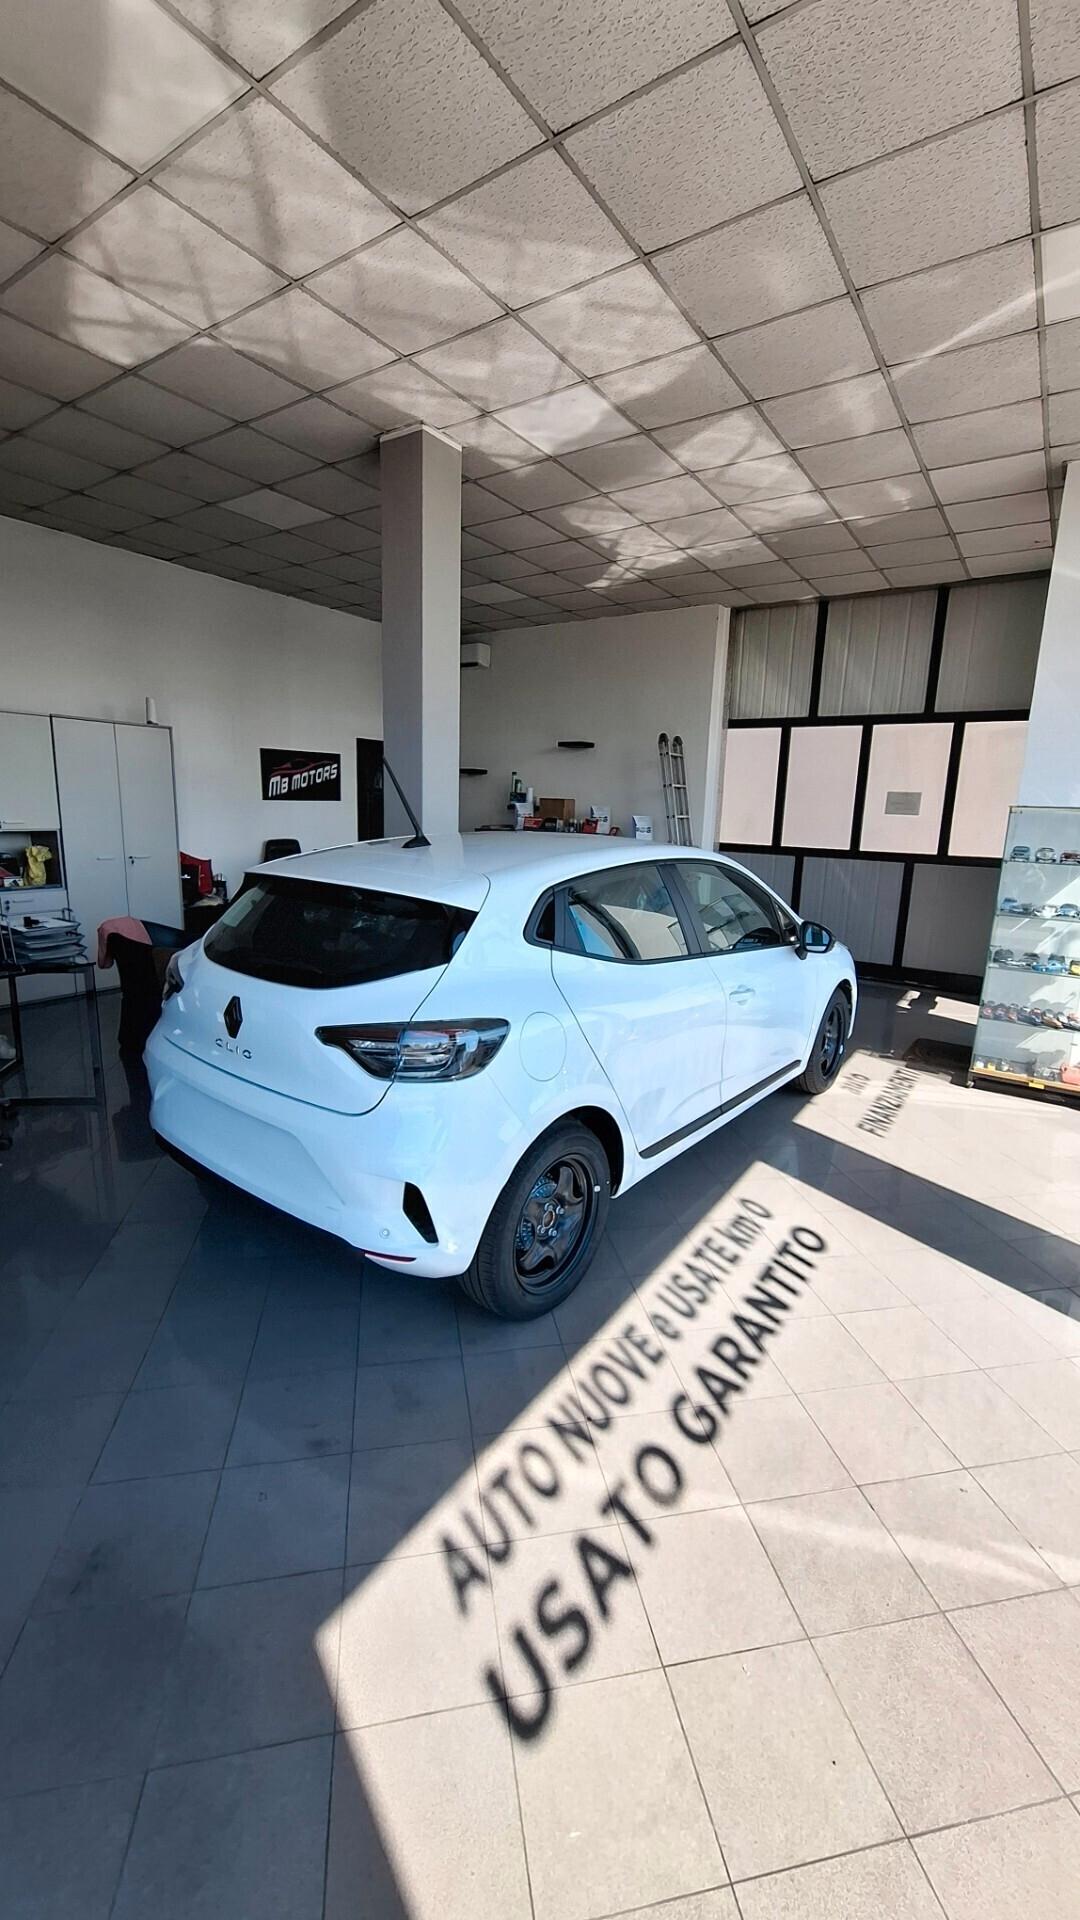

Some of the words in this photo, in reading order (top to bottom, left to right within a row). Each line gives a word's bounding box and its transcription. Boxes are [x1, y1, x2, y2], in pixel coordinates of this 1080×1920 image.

[268, 775, 289, 797] MB
[291, 763, 338, 790] MOTORS
[215, 1038, 252, 1060] CLIO
[712, 1215, 763, 1250] km
[656, 1237, 741, 1321] USATE
[652, 1313, 680, 1339] e
[546, 1324, 664, 1461] NUOVE
[481, 1444, 685, 1743] USATO
[669, 1226, 828, 1445] GARANTITO
[439, 1443, 562, 1614] AUTO
